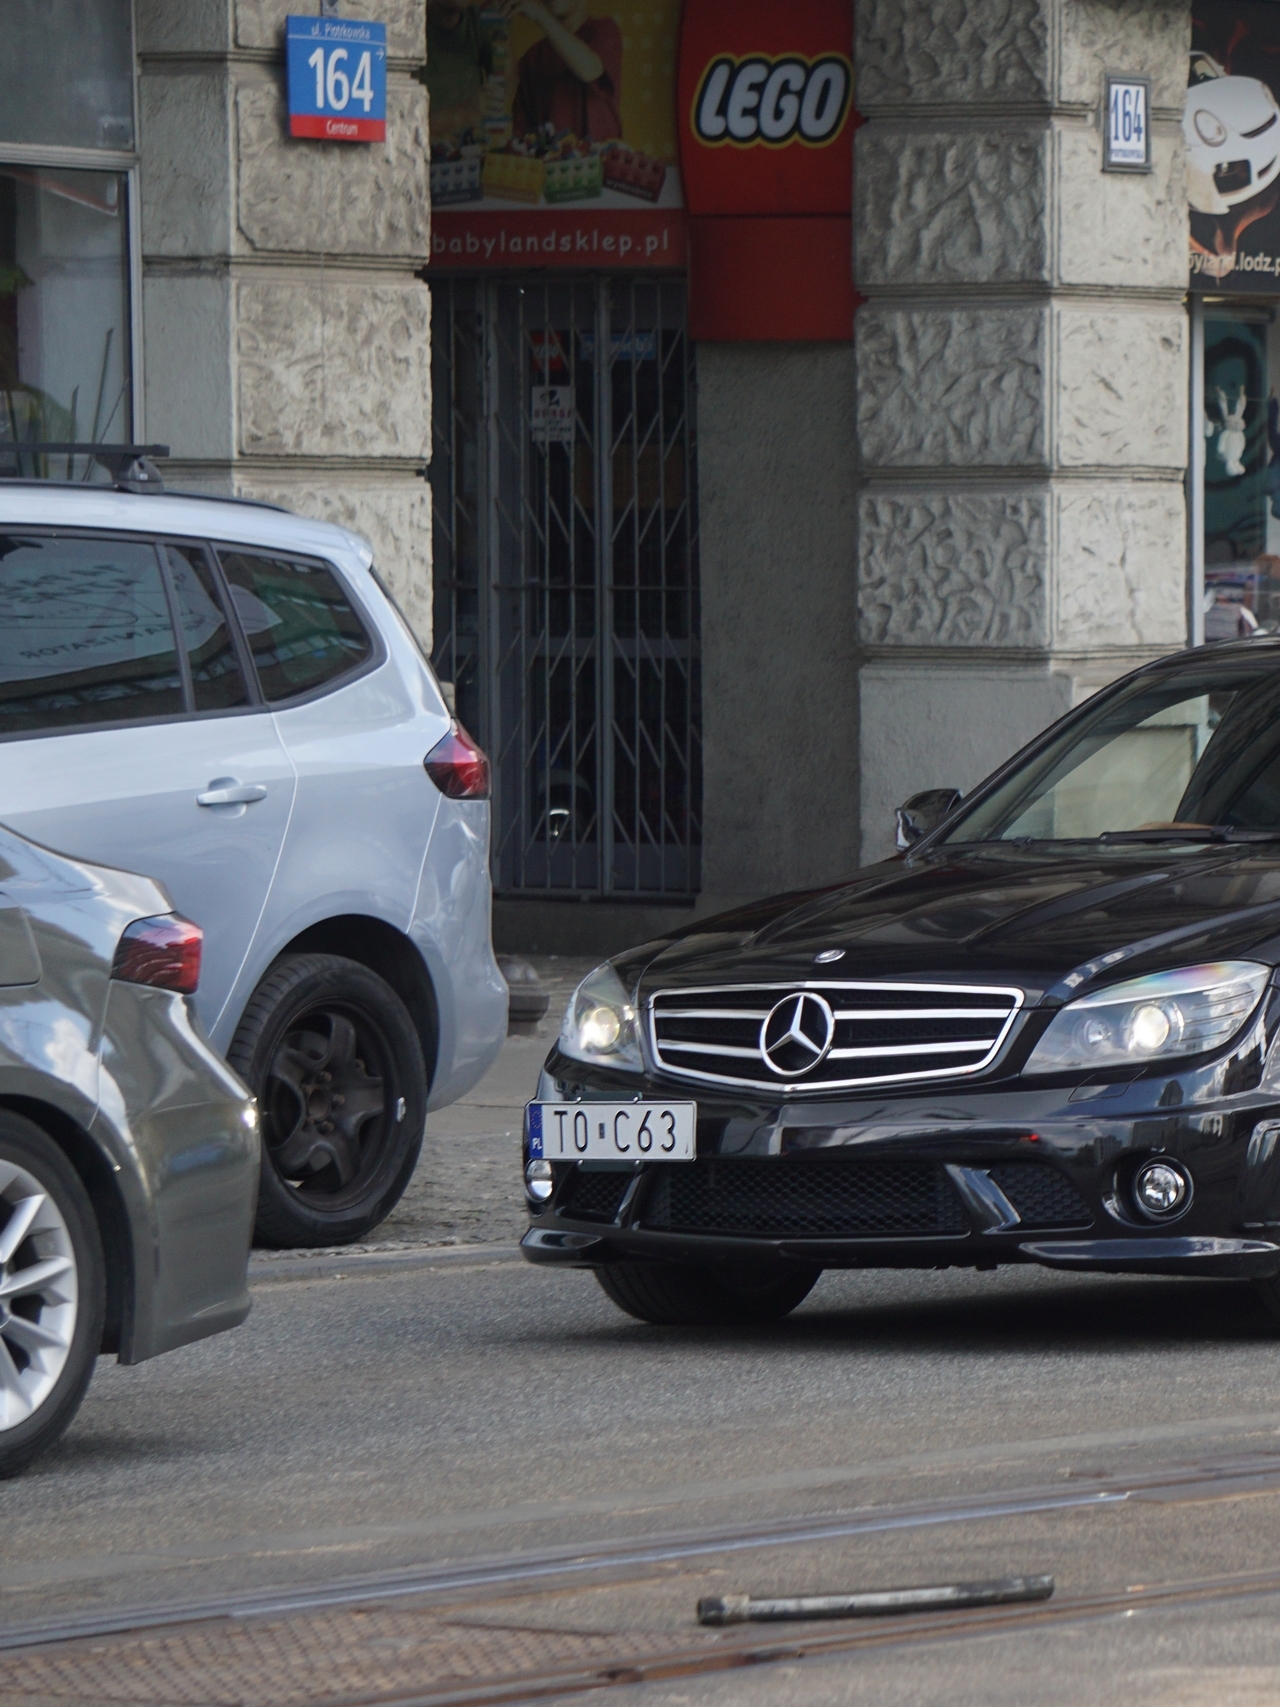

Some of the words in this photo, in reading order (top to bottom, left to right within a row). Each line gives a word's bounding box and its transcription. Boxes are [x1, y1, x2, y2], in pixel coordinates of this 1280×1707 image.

[325, 23, 371, 40] Piotrkowska
[308, 47, 374, 112] 164
[697, 57, 848, 140] LEGO
[326, 120, 359, 136] Centrum
[1111, 88, 1143, 142] 164
[432, 228, 669, 259] babylandsklep.pl
[532, 1136, 543, 1150] PL
[614, 1110, 676, 1153] C63
